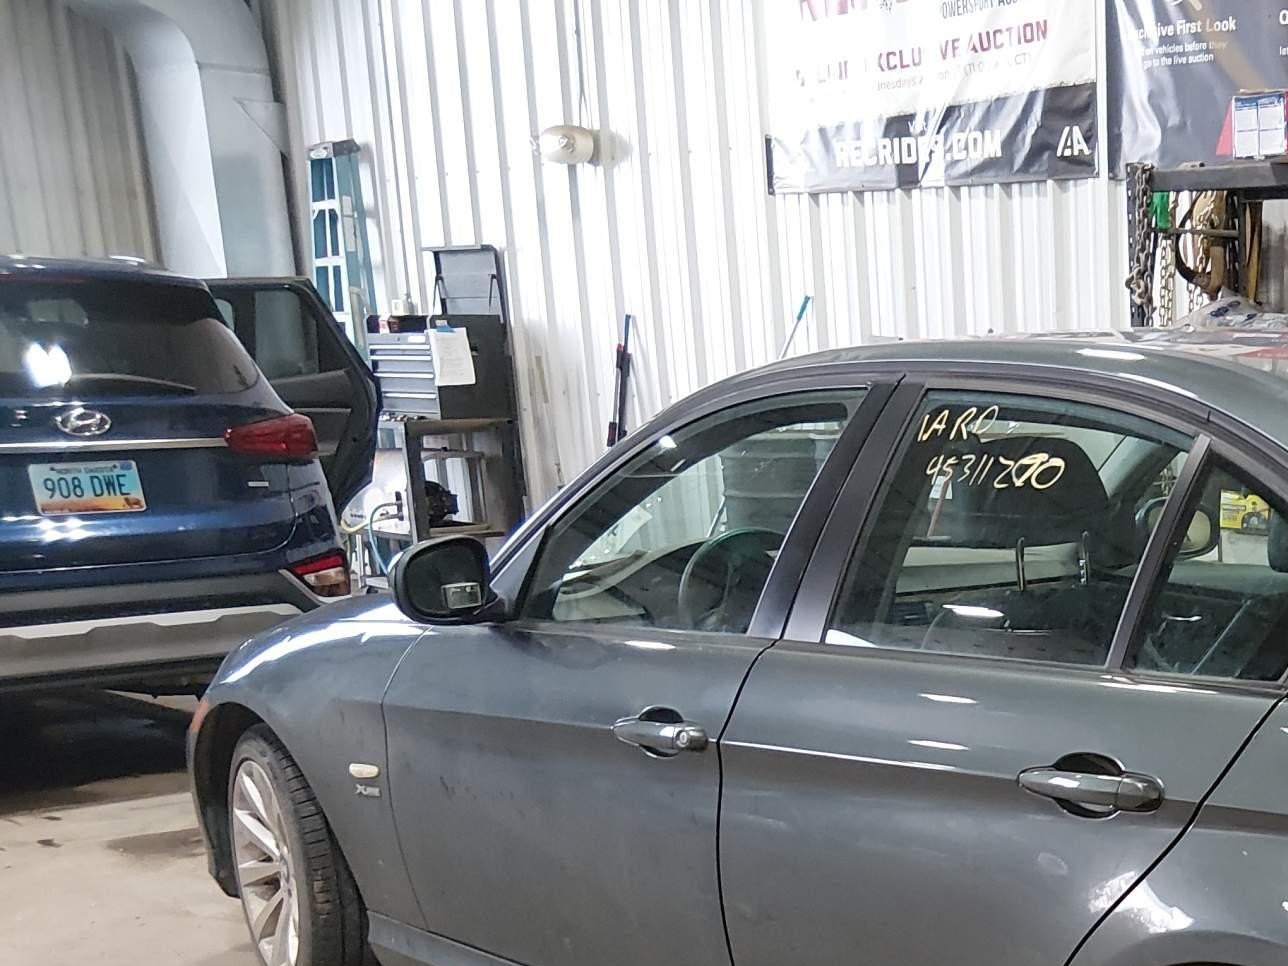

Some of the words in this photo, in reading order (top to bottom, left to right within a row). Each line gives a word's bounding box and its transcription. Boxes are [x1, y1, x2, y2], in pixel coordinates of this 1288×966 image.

[968, 19, 1048, 53] AUCTION
[1176, 19, 1202, 36] First
[1206, 16, 1237, 33] Look
[1155, 44, 1184, 55] vehicles
[1185, 41, 1207, 52] before
[1153, 57, 1160, 66] to
[1161, 55, 1172, 66] the
[1174, 53, 1187, 64] live
[1188, 52, 1214, 64] auction
[43, 476, 84, 499] 908
[90, 474, 131, 497] DWE
